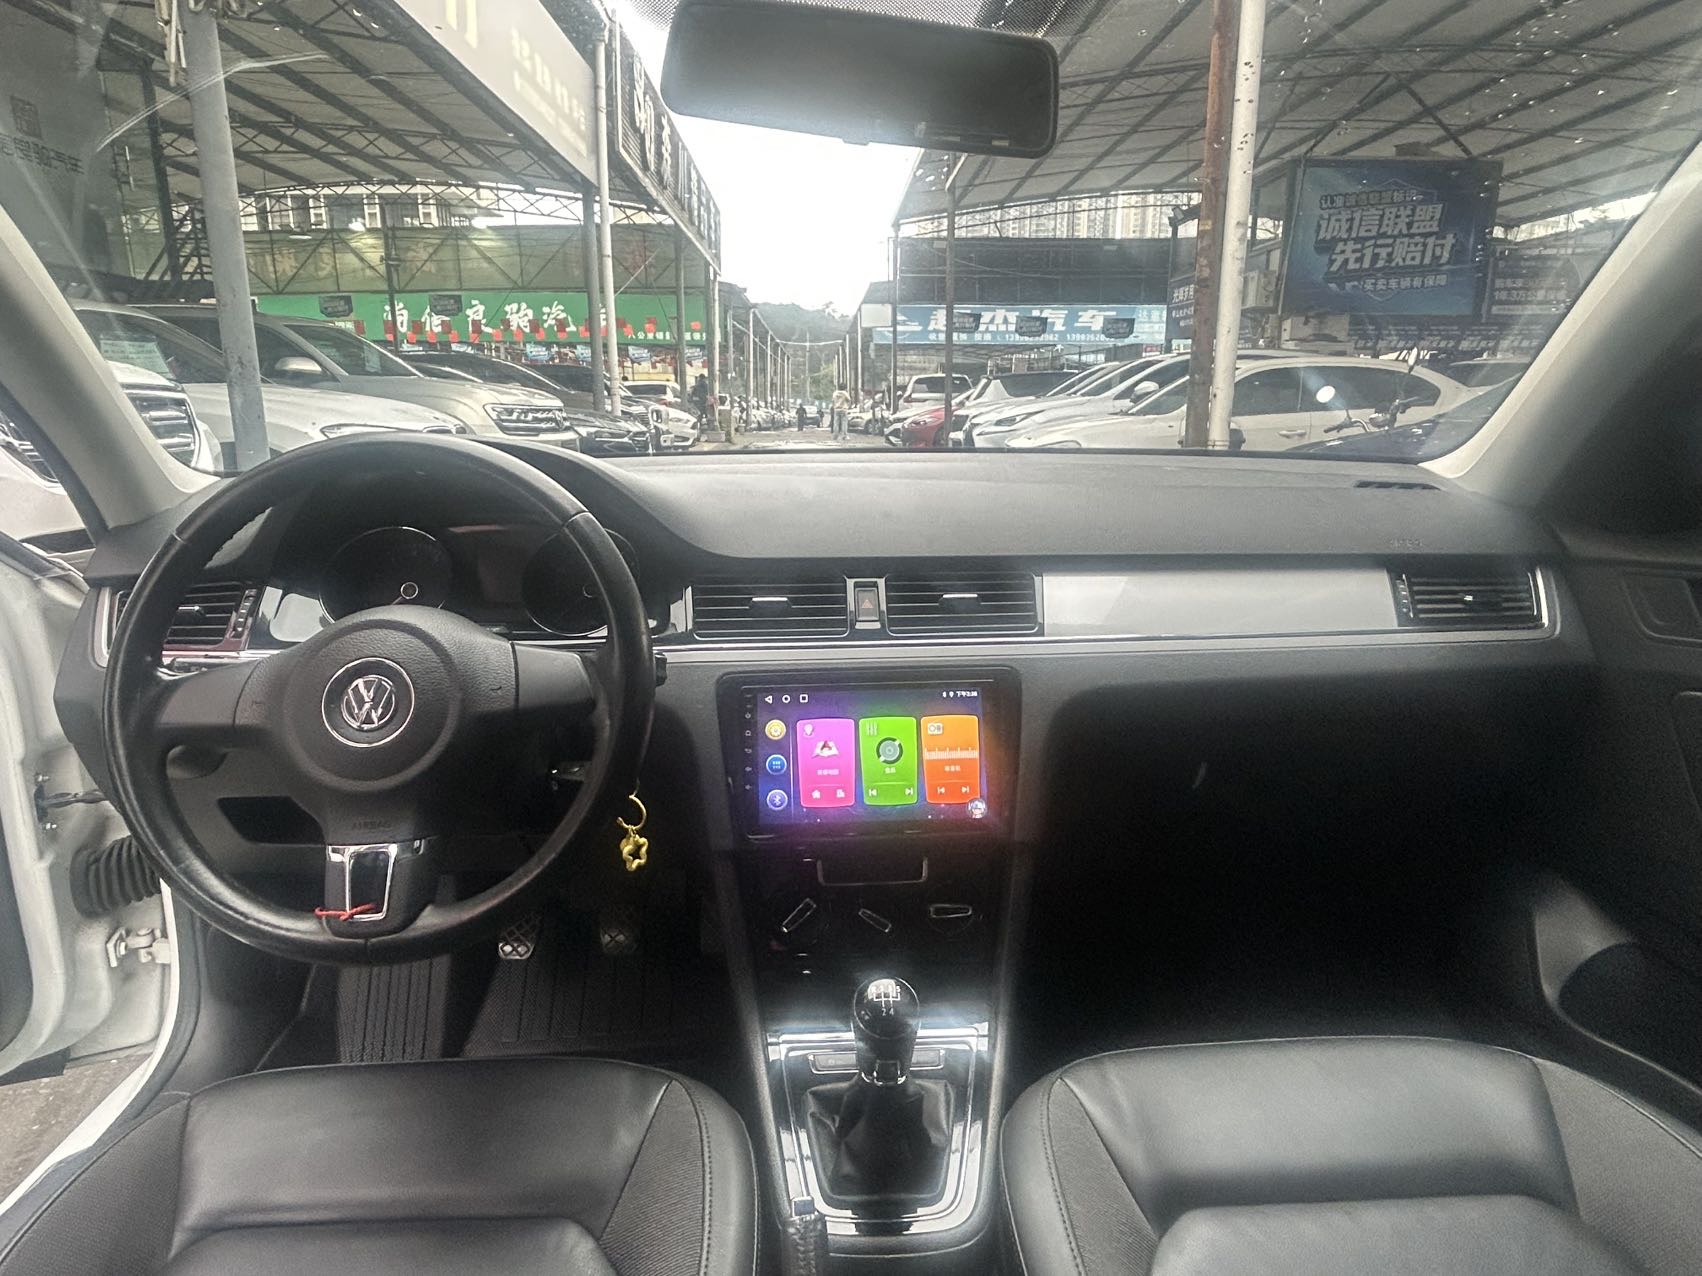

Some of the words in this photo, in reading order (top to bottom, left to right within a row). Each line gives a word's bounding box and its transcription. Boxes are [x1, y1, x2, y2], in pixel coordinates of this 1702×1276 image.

[1318, 203, 1443, 240] 诚信联盟
[1329, 233, 1457, 271] 先行赔付
